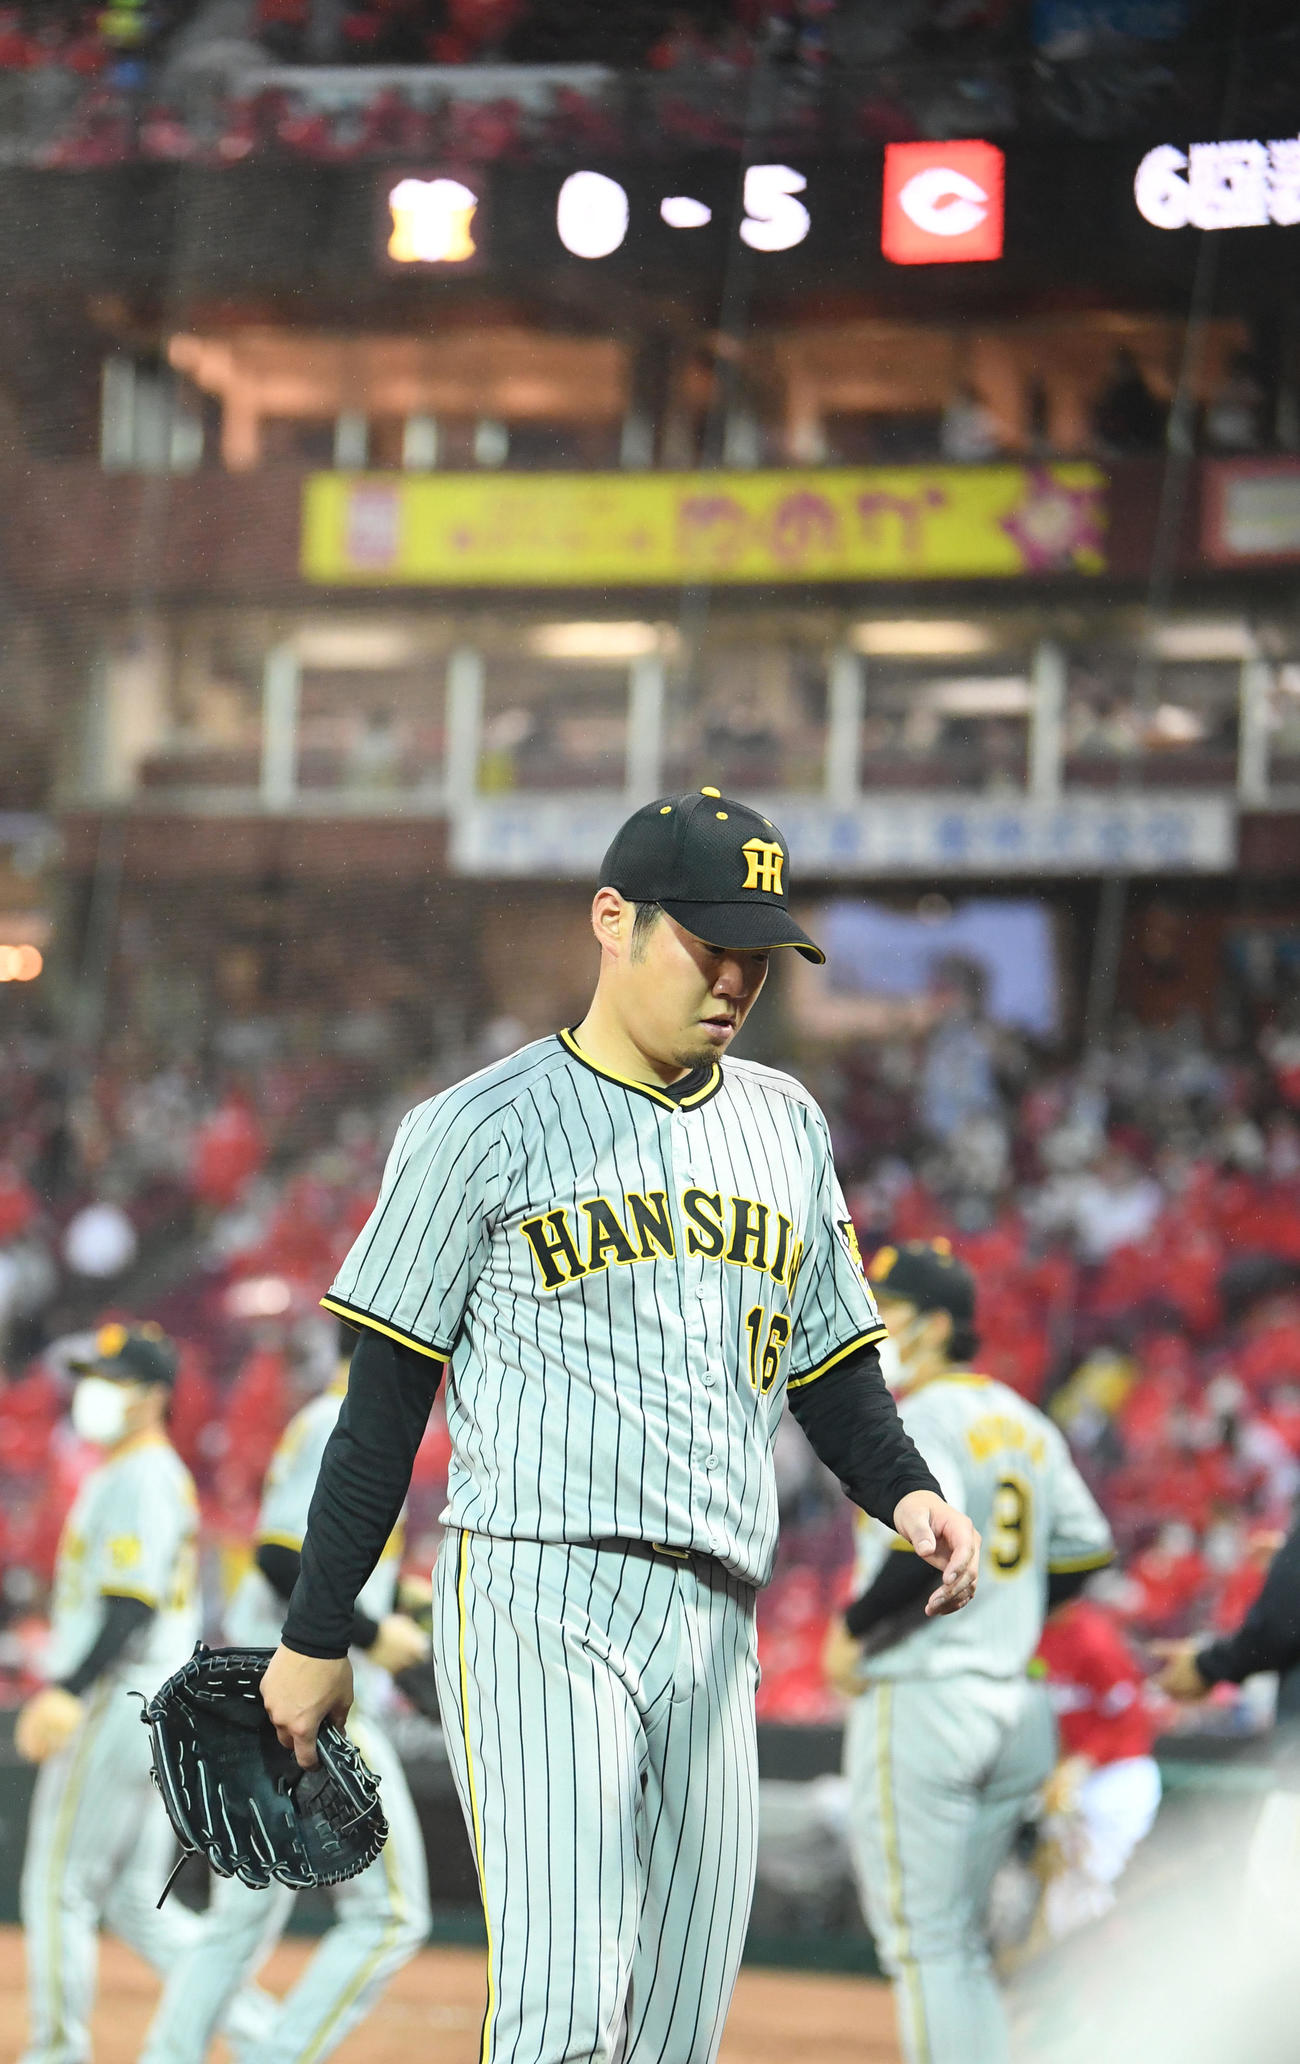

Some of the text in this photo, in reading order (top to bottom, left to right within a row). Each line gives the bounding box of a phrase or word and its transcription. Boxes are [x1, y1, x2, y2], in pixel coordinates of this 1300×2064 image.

[556, 170, 629, 259] 0
[739, 164, 811, 252] 5
[745, 1305, 792, 1395] 16
[989, 1474, 1034, 1580] 3
